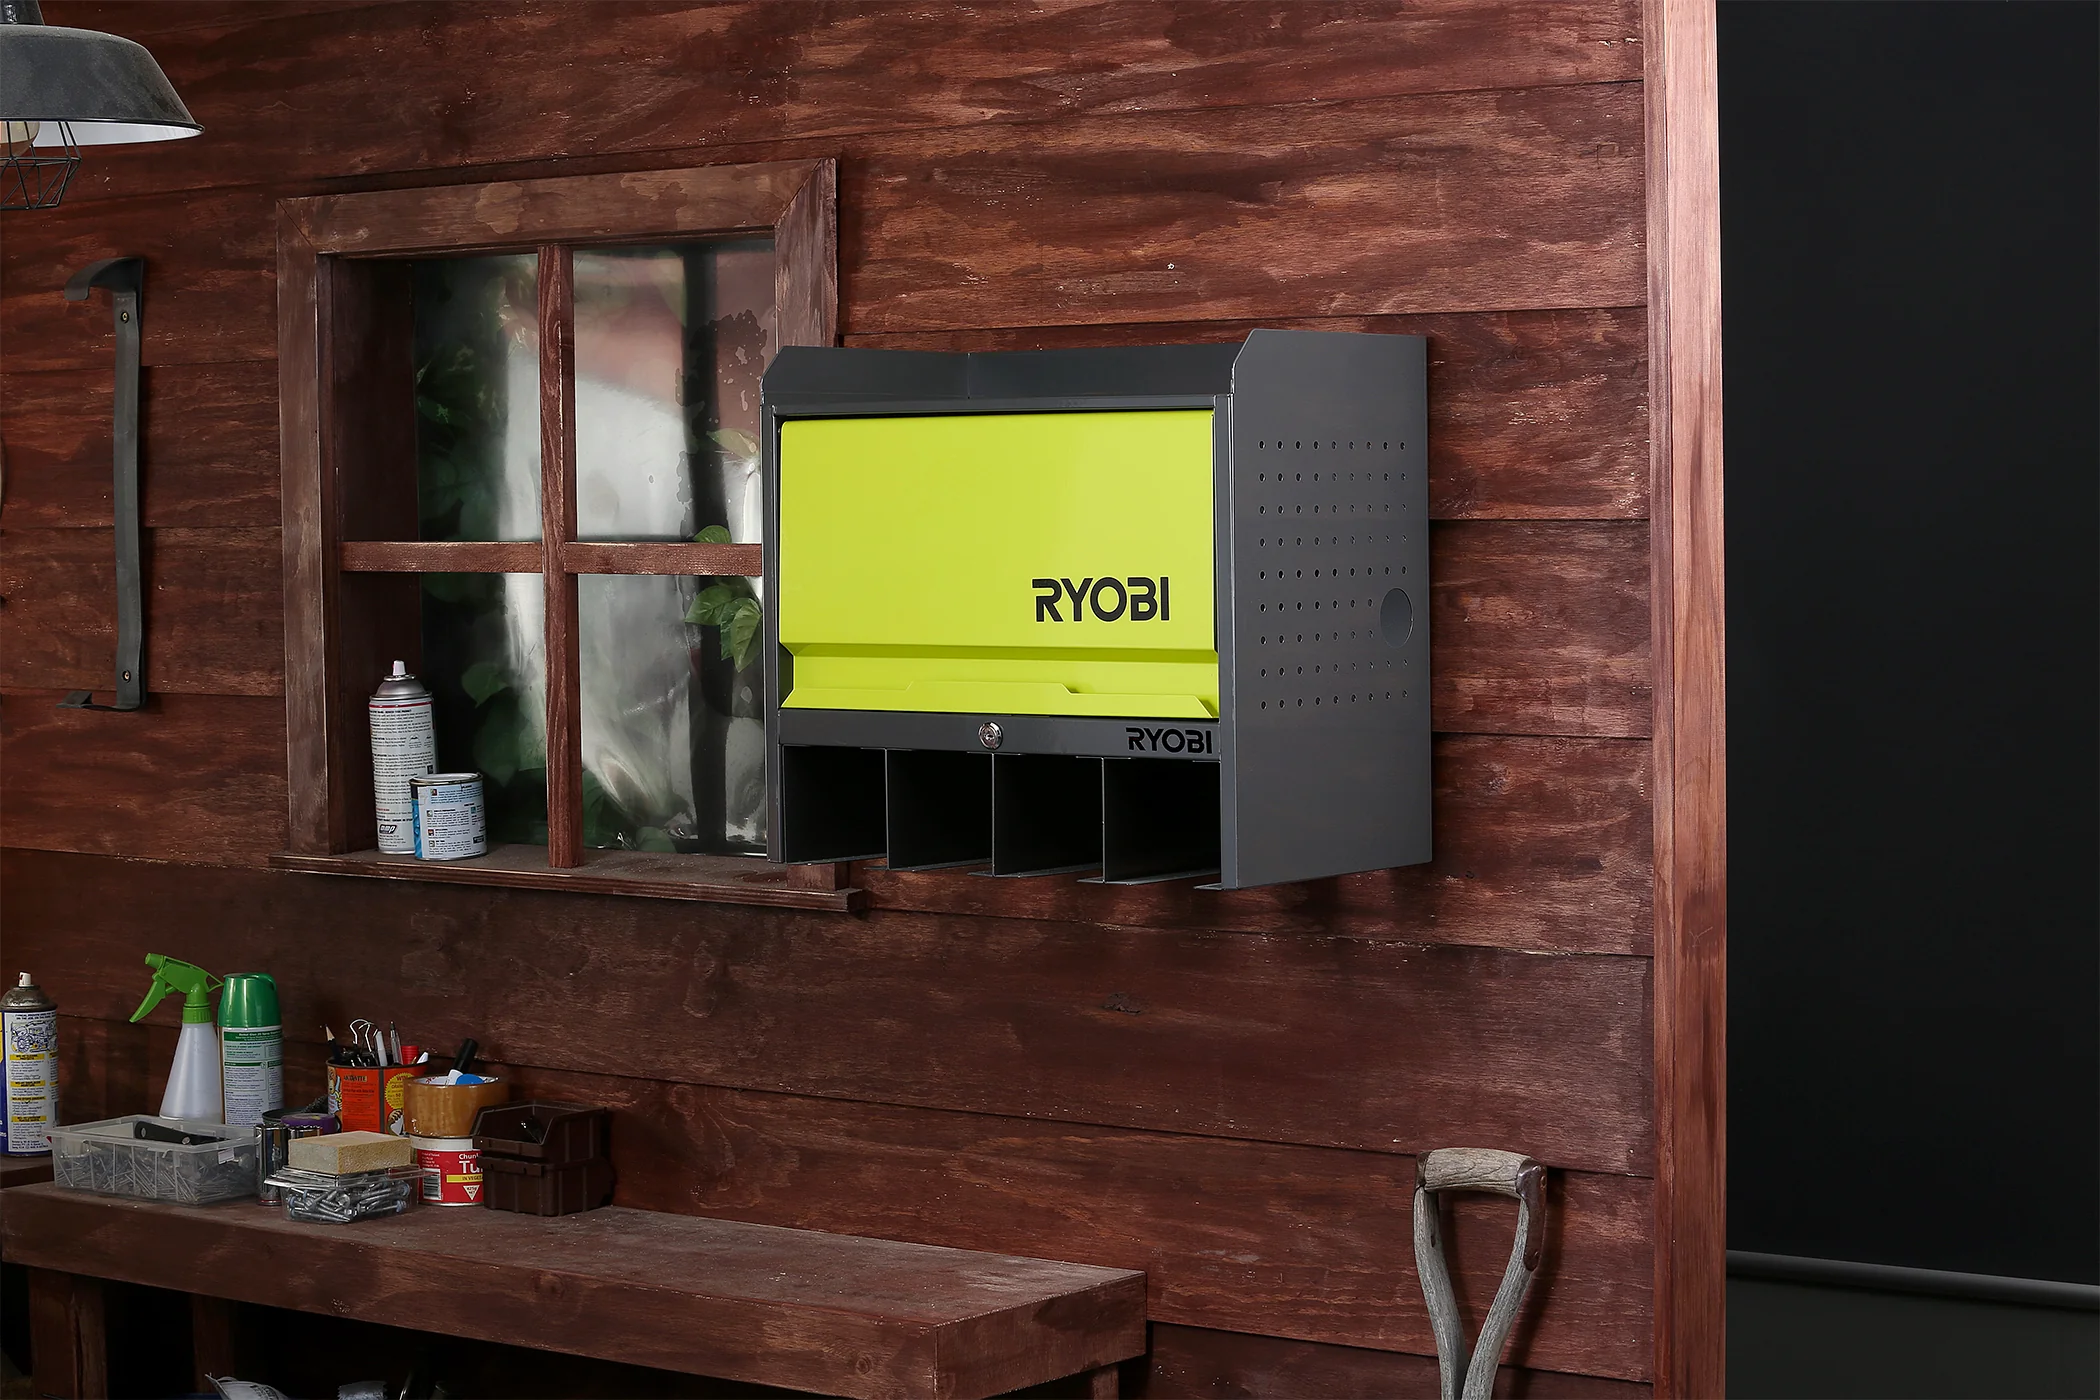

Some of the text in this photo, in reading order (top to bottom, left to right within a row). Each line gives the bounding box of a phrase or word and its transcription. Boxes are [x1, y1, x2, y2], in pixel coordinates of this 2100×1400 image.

[1032, 577, 1170, 622] RYOBI
[1125, 727, 1213, 754] RYOBI
[458, 1160, 483, 1174] Tu
